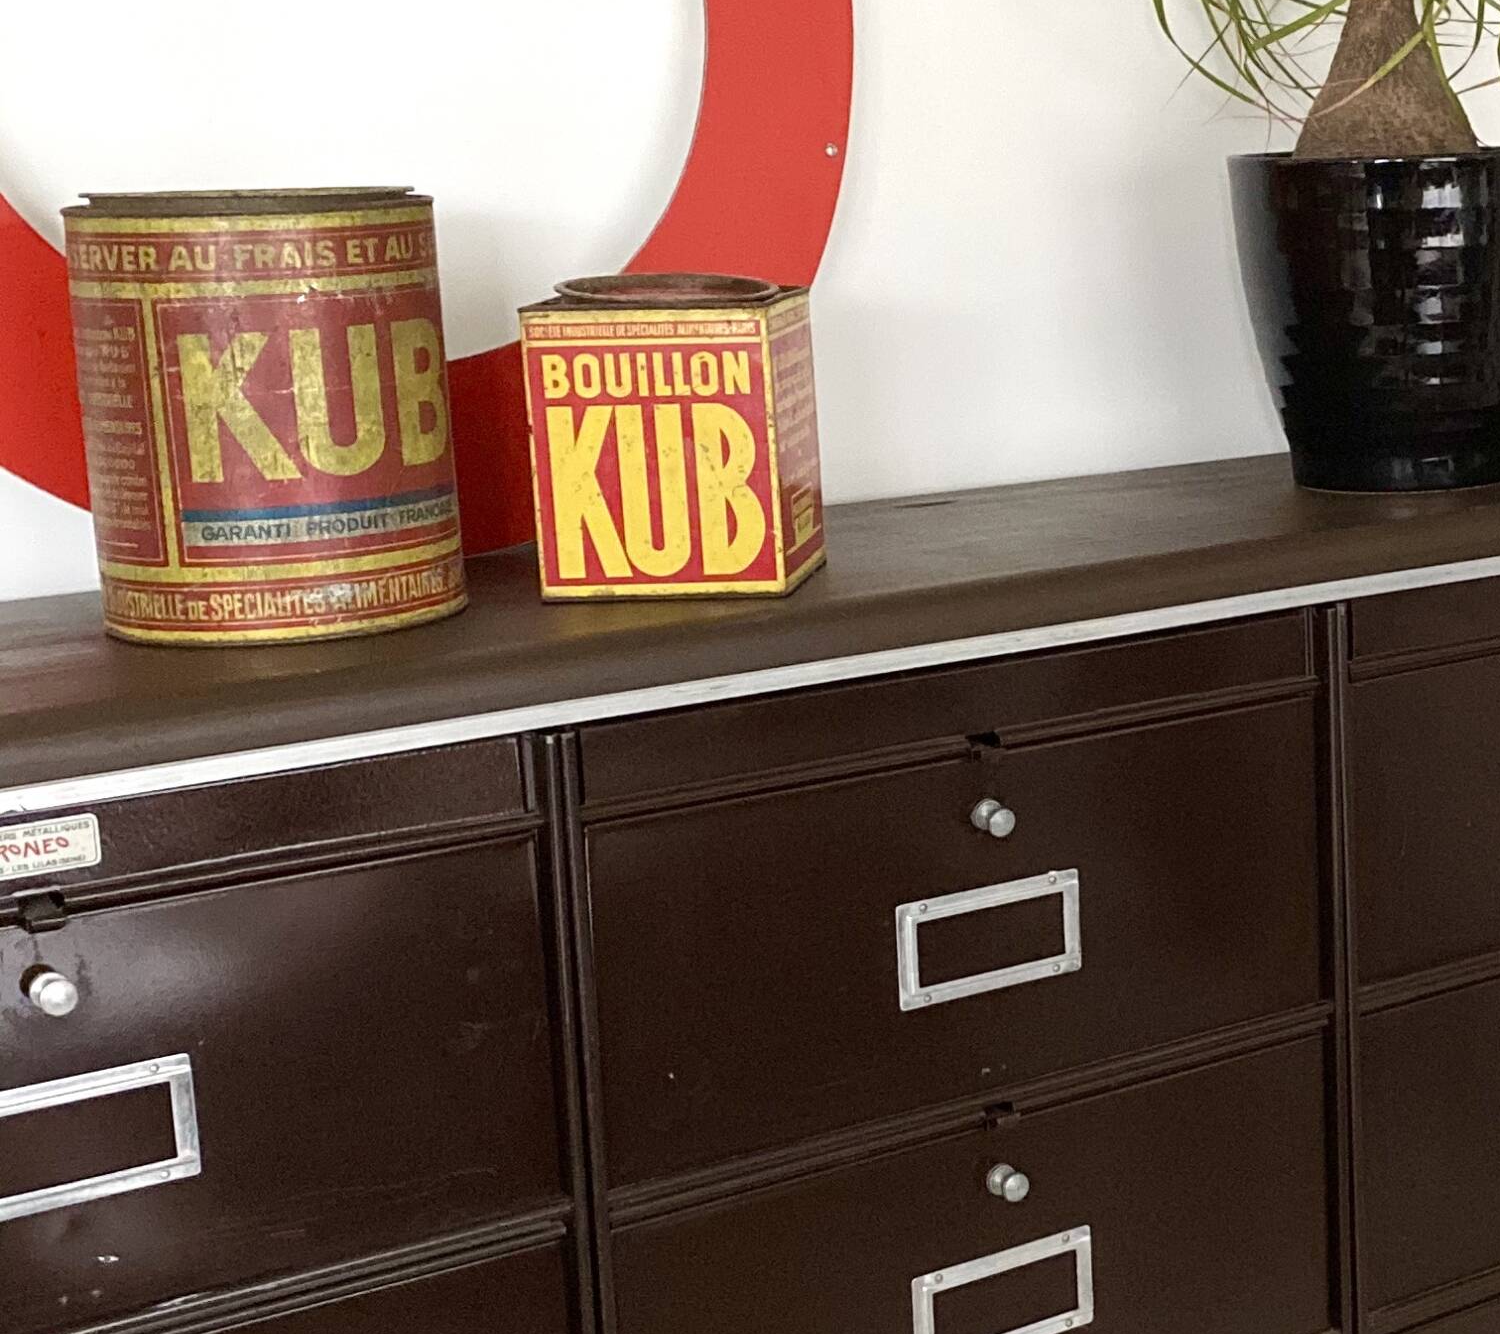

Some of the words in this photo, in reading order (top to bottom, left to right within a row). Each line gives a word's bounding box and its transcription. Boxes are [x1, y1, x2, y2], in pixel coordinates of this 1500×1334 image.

[168, 244, 217, 271] AU
[233, 240, 337, 269] FRAIS
[346, 237, 379, 264] ET
[384, 233, 413, 262] AU
[541, 351, 751, 399] BOUILLON
[177, 317, 449, 483] KUB
[545, 403, 766, 579] KUB
[201, 522, 292, 542] GARANTI
[306, 512, 389, 536] PRODUIT
[188, 600, 209, 620] DE
